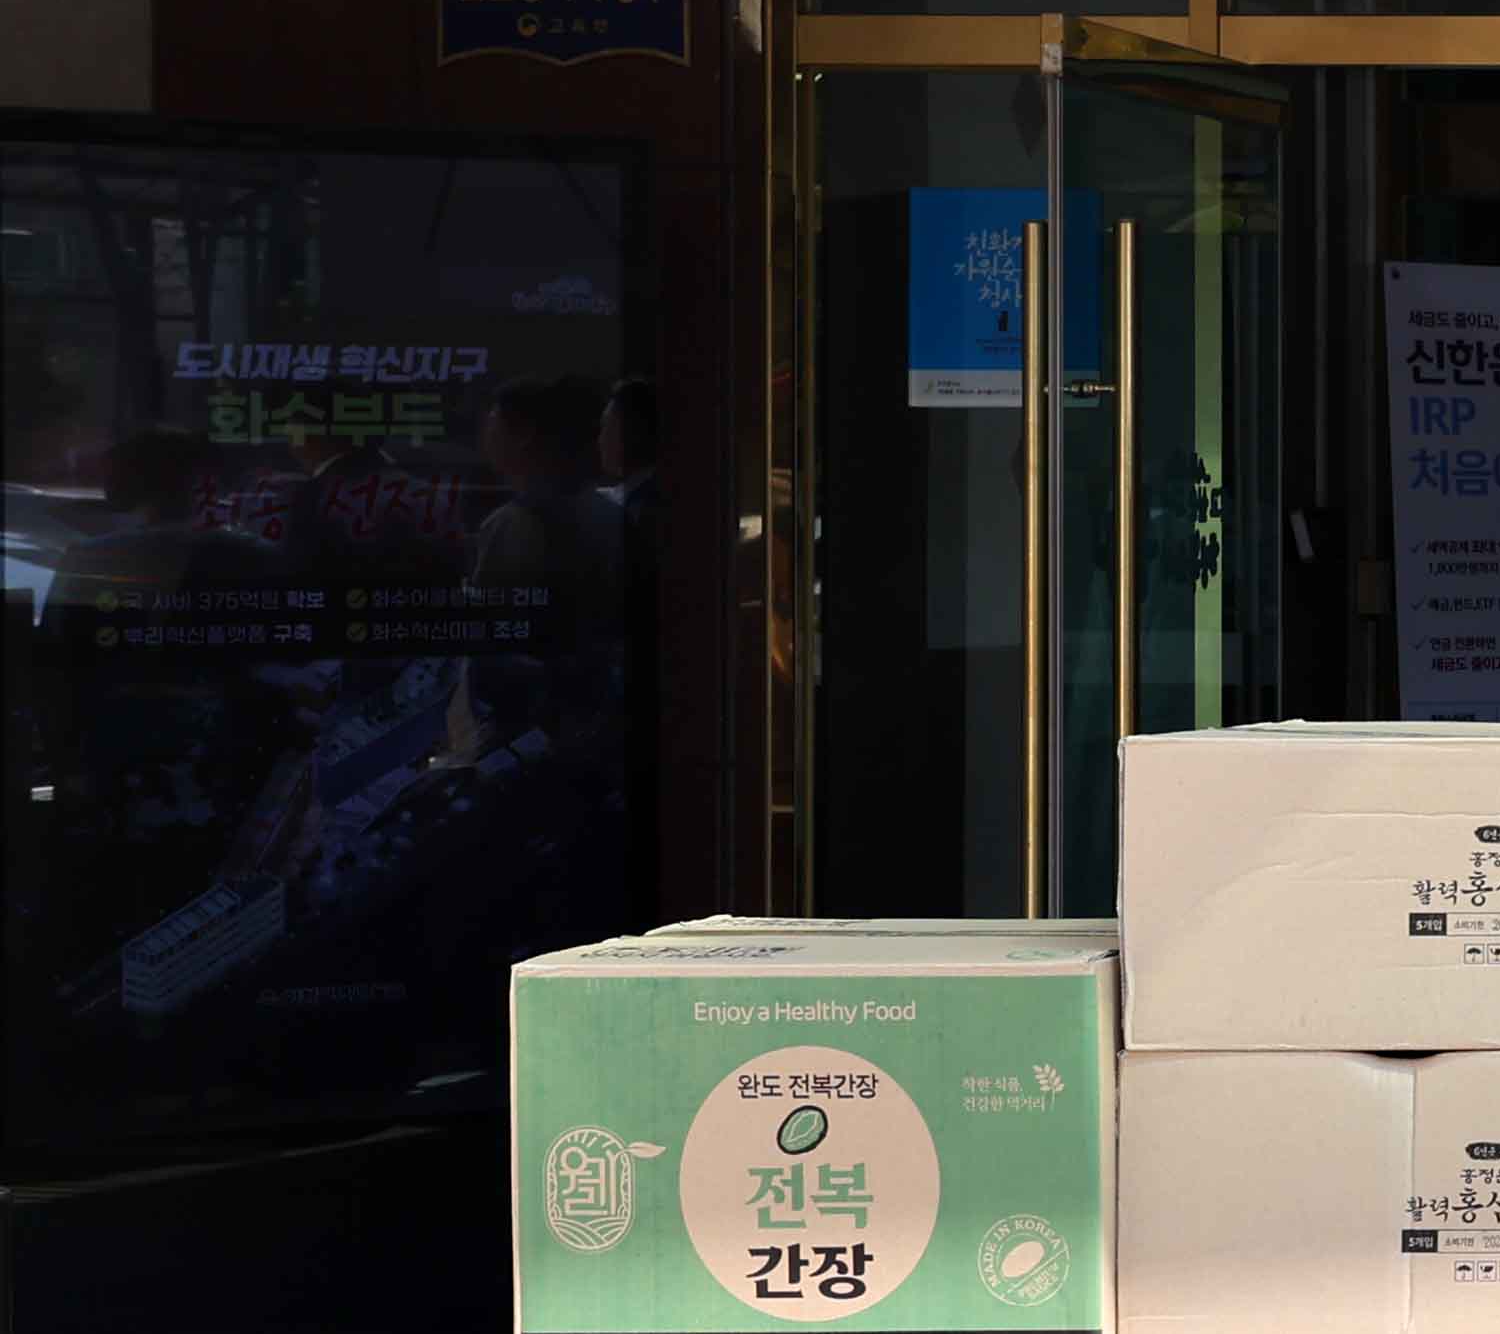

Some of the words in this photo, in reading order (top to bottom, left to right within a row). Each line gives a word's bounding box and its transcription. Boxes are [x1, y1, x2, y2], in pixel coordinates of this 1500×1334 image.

[1407, 311, 1450, 329] 세금도
[173, 342, 331, 381] 도시재생
[339, 343, 488, 383] 혁신지구
[207, 391, 447, 447] 화수부두
[1409, 396, 1475, 435] IRP
[693, 1000, 753, 1024] Enjoy
[758, 1004, 770, 1020] a
[775, 999, 858, 1024] Healthy
[864, 999, 916, 1020] Food
[737, 1075, 783, 1101] 완도
[788, 1075, 876, 1101] 전복간장
[963, 1077, 991, 1091] 착한
[963, 1094, 1003, 1109] 건강한
[1006, 1094, 1046, 1109] 먹거리
[745, 1162, 874, 1228] 전복
[746, 1245, 875, 1301] 간장
